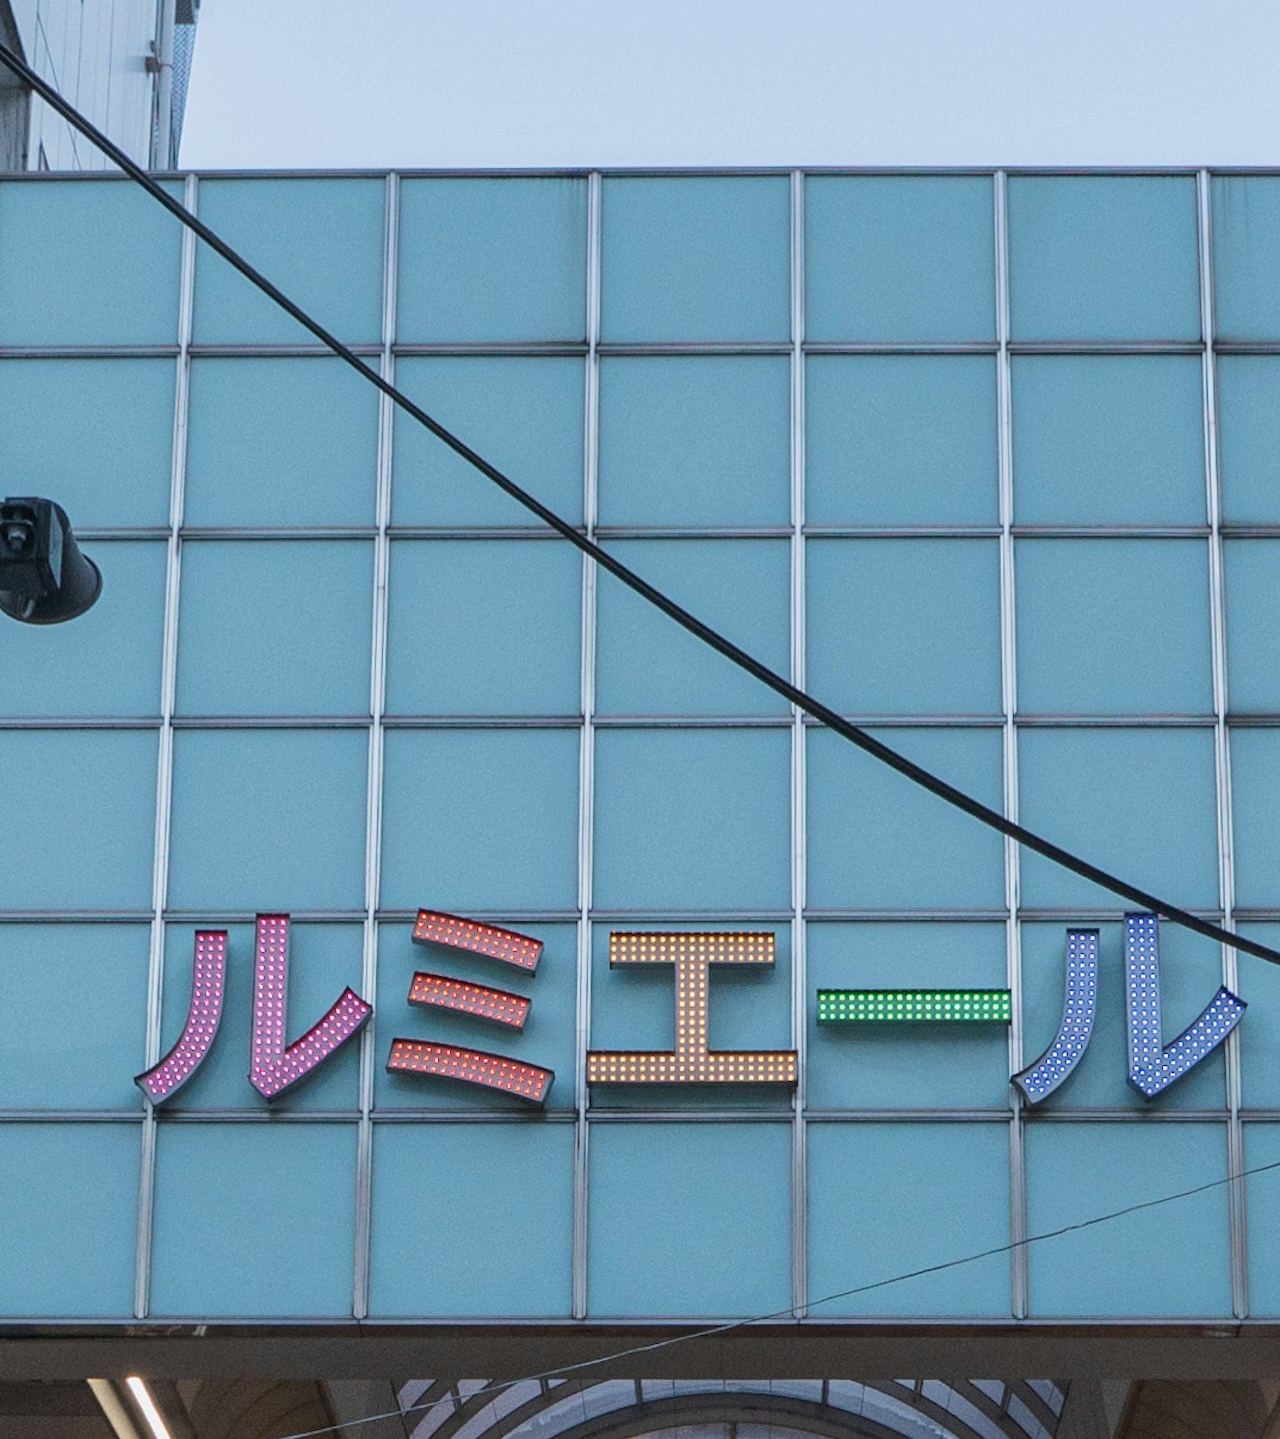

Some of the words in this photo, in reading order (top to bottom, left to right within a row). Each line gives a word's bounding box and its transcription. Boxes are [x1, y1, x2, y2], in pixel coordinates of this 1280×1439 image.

[134, 908, 1248, 1107] ルミエール
